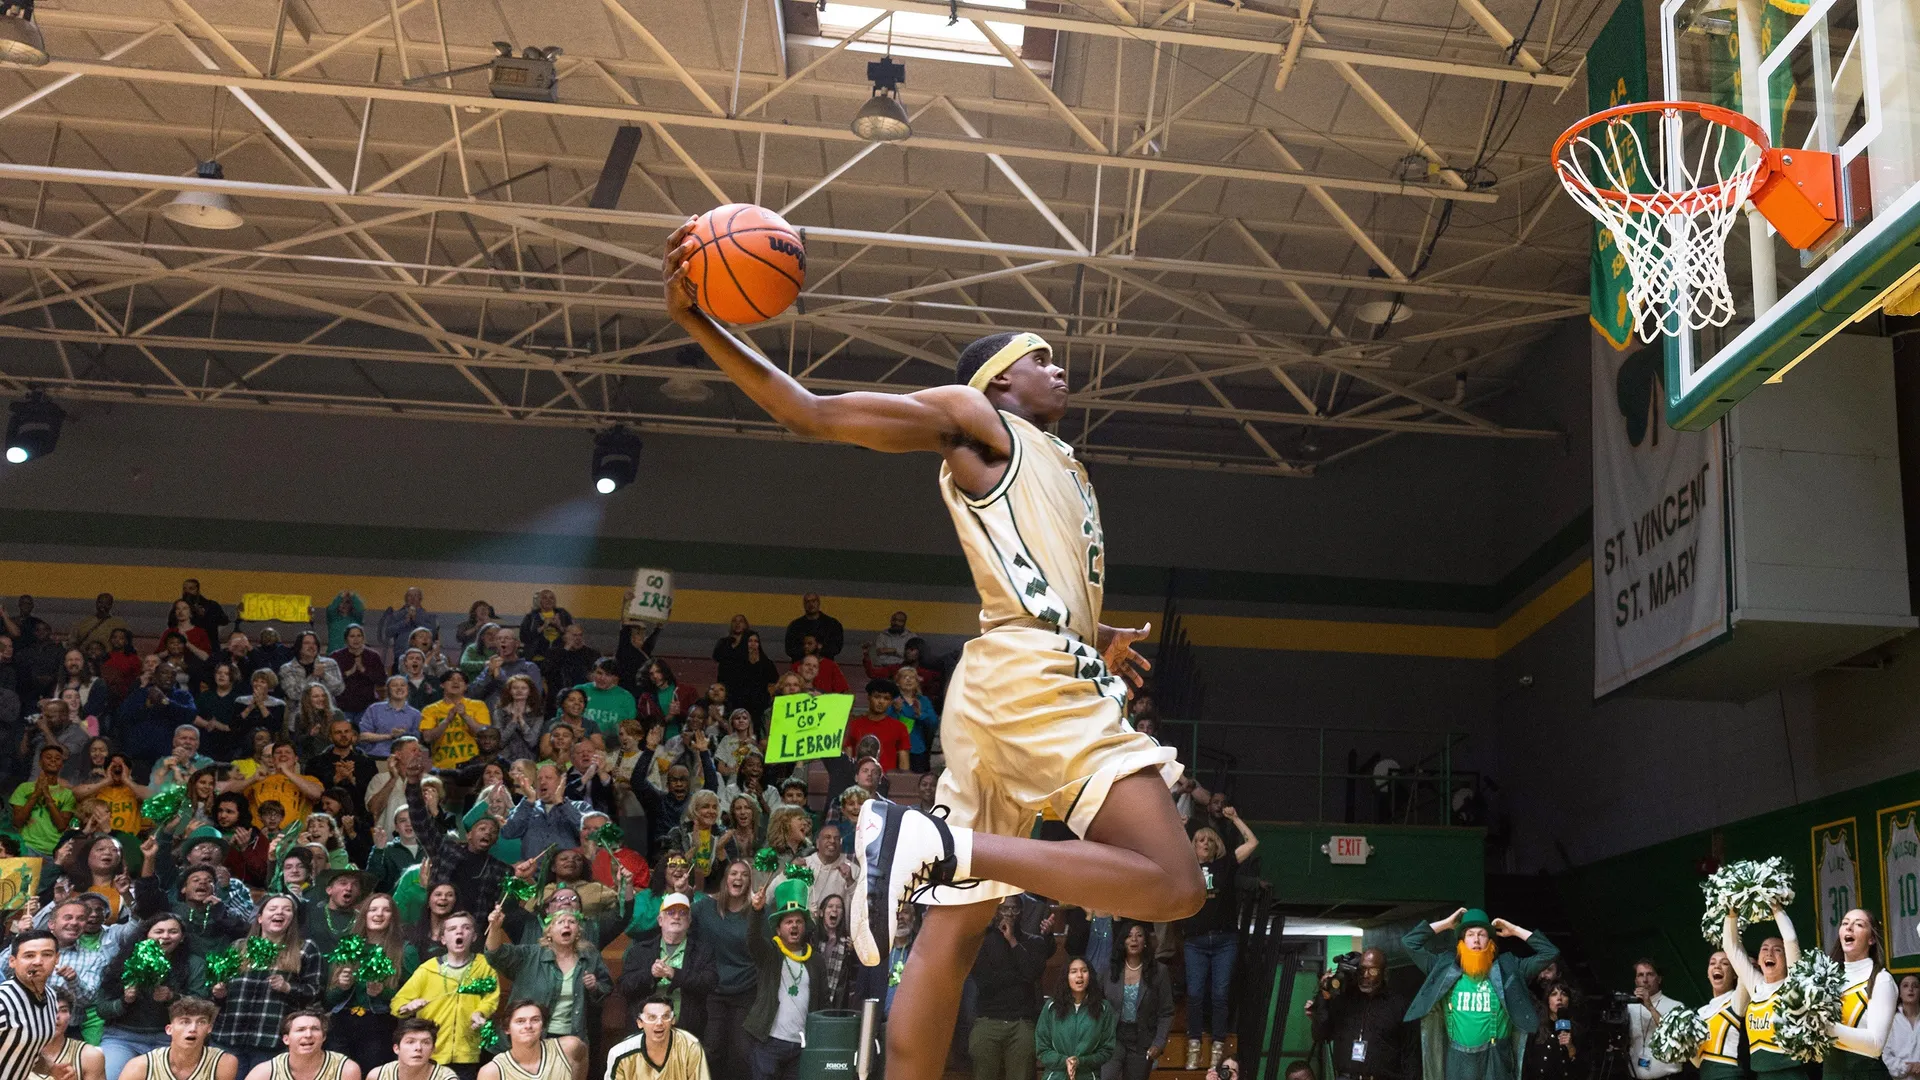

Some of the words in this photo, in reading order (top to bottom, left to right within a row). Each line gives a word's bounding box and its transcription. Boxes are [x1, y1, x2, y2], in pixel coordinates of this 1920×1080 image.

[1604, 531, 1629, 577] ST.
[1634, 462, 1710, 557] VINCENT
[646, 575, 664, 589] GO
[1616, 583, 1645, 628] ST.
[1649, 542, 1699, 612] MARY
[785, 698, 818, 718] LETS
[445, 731, 463, 743] TO
[780, 729, 842, 758] LEBRON
[433, 744, 475, 762] STATE
[1338, 838, 1363, 856] EXIT
[1898, 872, 1918, 918] 10
[1828, 885, 1849, 927] 30
[1456, 991, 1491, 1012] IRISH
[1748, 1012, 1770, 1030] Irish
